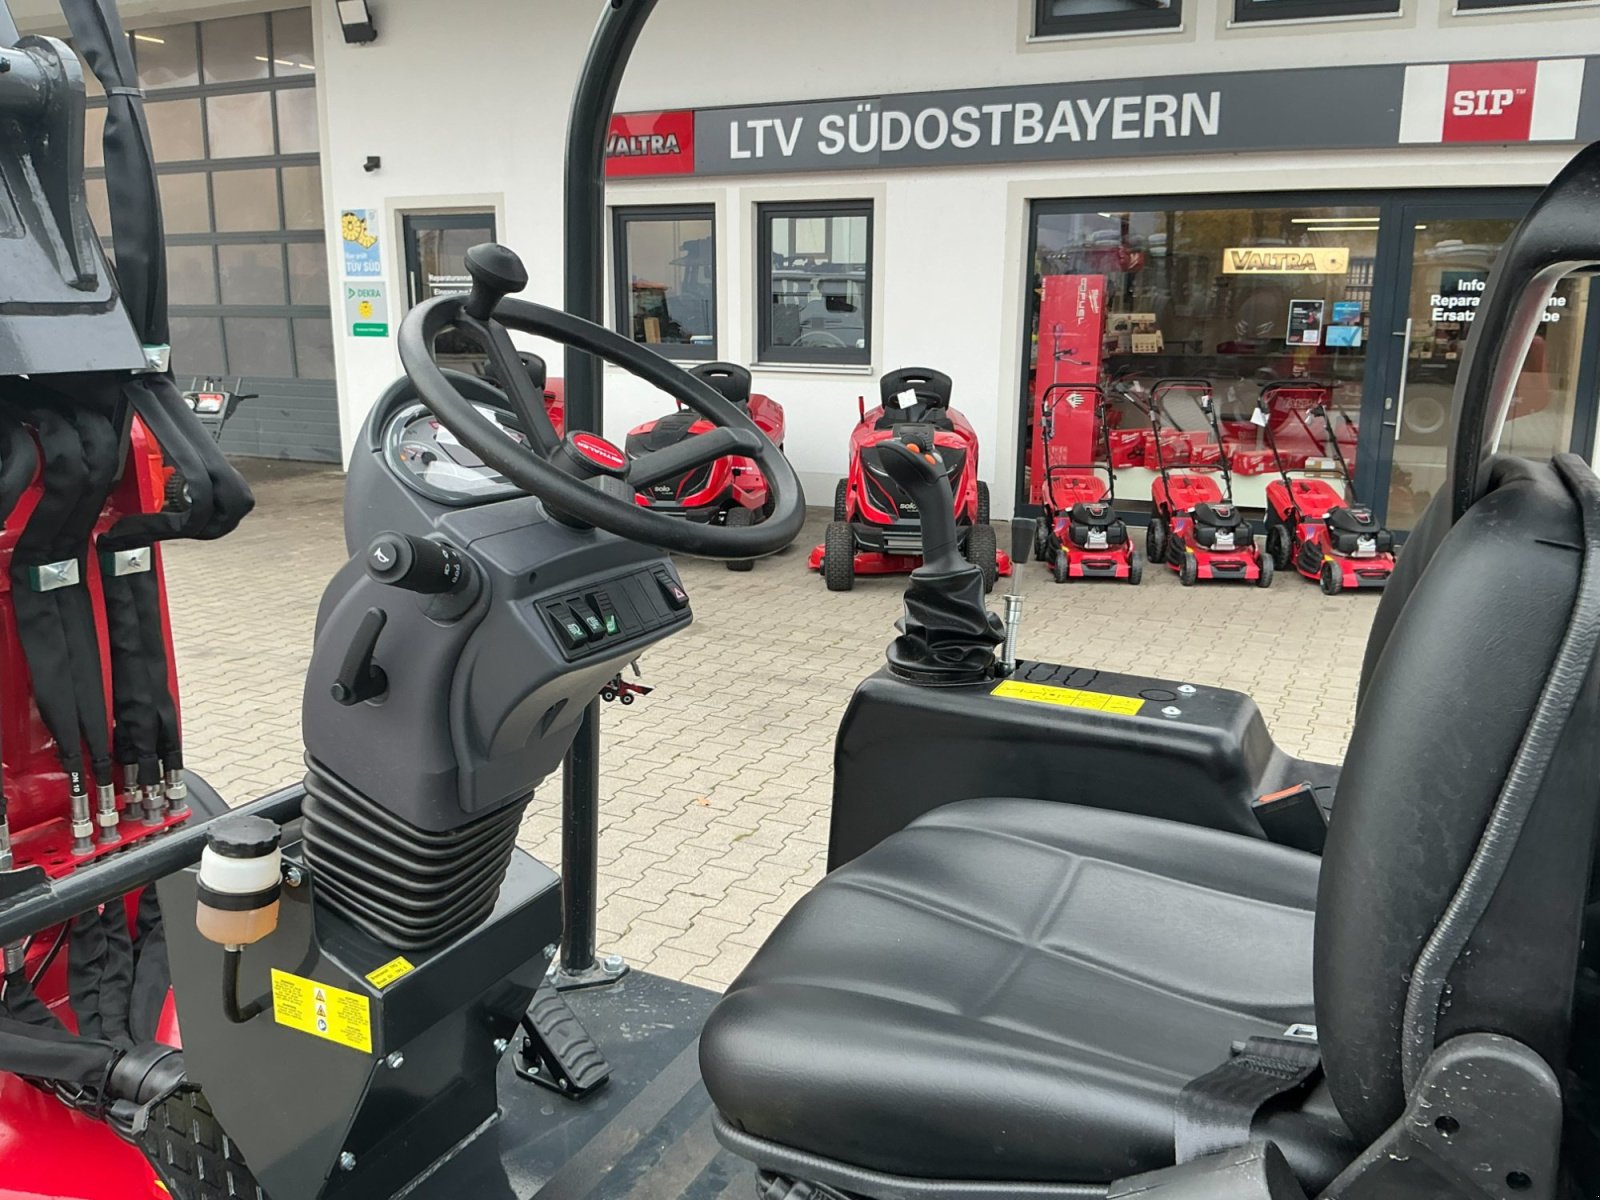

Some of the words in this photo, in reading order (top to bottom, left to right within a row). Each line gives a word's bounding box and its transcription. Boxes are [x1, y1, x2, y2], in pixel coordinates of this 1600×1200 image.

[1452, 88, 1514, 116] SIP
[730, 117, 804, 159] LTV
[817, 91, 1221, 155] SÜDOSTBAYERN
[346, 259, 362, 273] TÜV
[363, 258, 381, 273] SÜD
[1230, 250, 1317, 271] VALTRA
[357, 289, 381, 298] DEKRA
